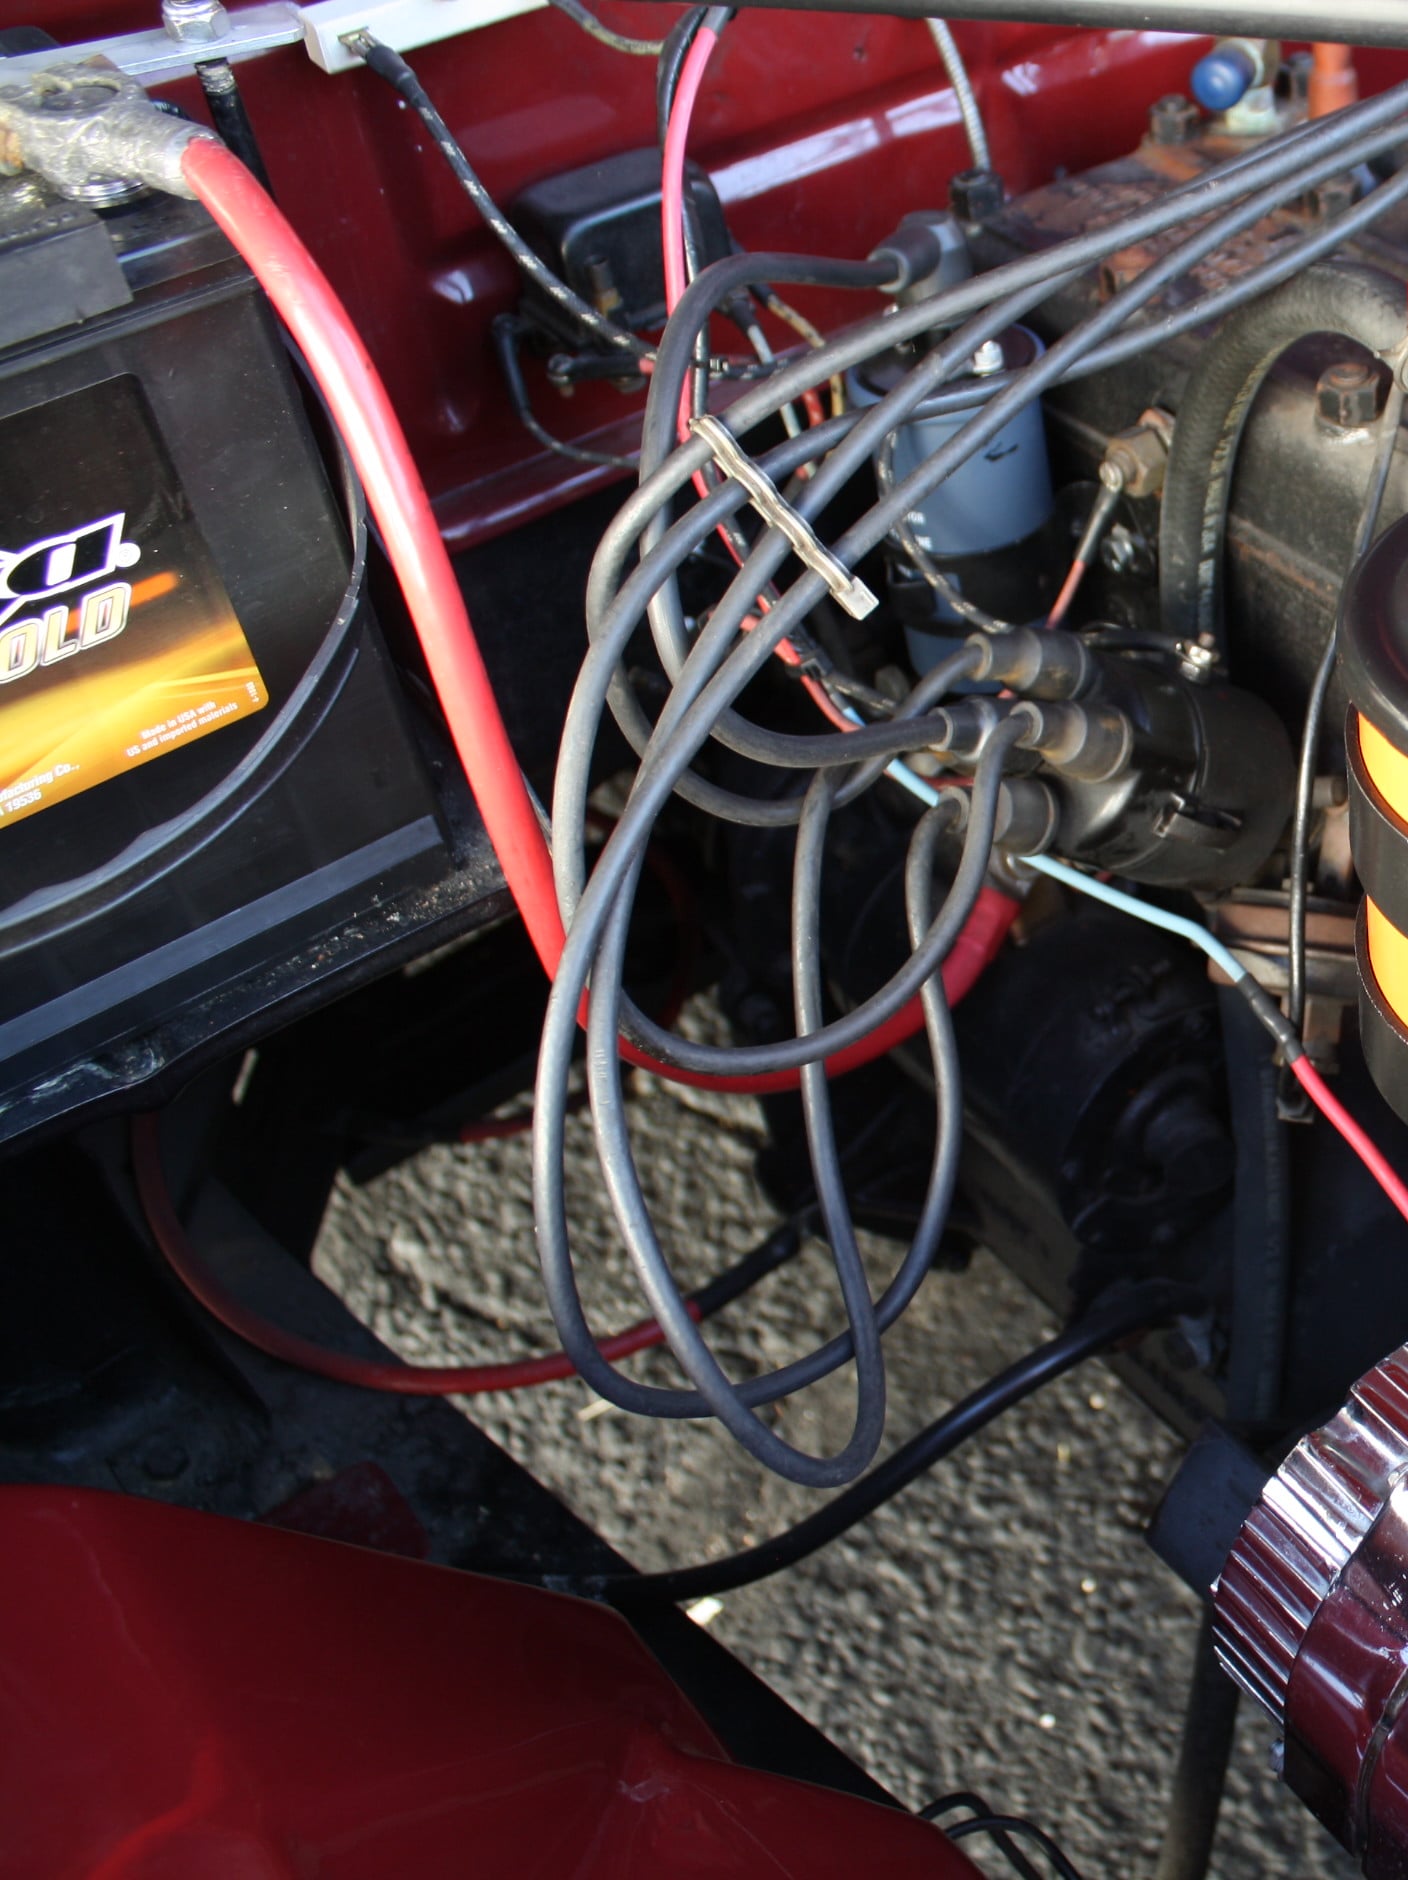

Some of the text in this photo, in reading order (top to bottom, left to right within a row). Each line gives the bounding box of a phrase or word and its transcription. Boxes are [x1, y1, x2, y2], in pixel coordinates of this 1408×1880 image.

[126, 703, 237, 756] US and imported materials
[177, 710, 197, 723] USA
